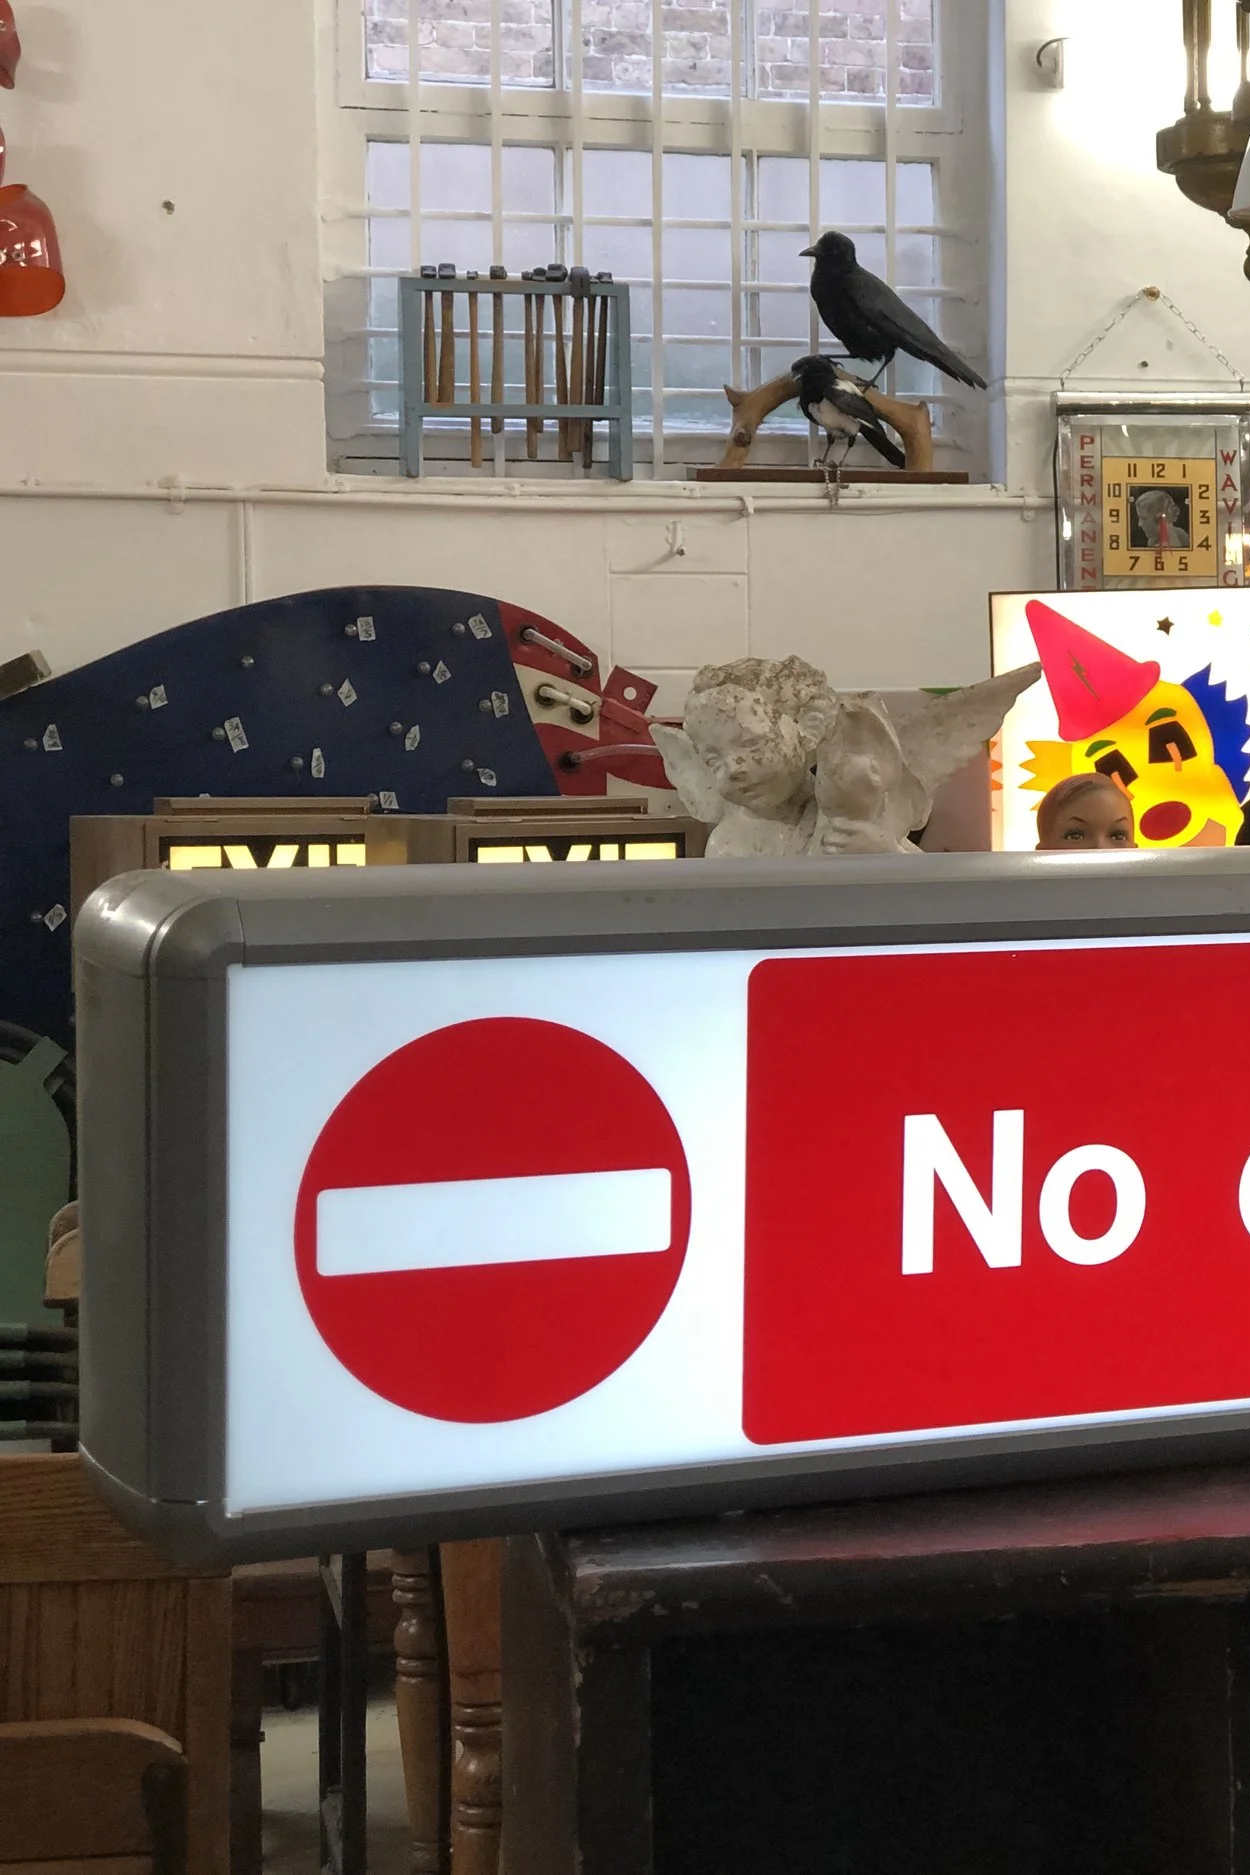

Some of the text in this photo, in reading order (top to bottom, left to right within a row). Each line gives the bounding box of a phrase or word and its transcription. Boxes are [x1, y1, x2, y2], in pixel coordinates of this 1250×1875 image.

[1127, 463, 1187, 479] 11 12 1
[1107, 483, 1122, 498] 10
[1198, 484, 1210, 500] 2
[1109, 509, 1120, 523] 9
[1199, 510, 1210, 525] 3
[1220, 449, 1239, 587] WAVIG
[1109, 535, 1120, 550] 8
[1197, 536, 1212, 551] 4
[1129, 556, 1188, 571] 7 6 5
[901, 1109, 1146, 1276] No
